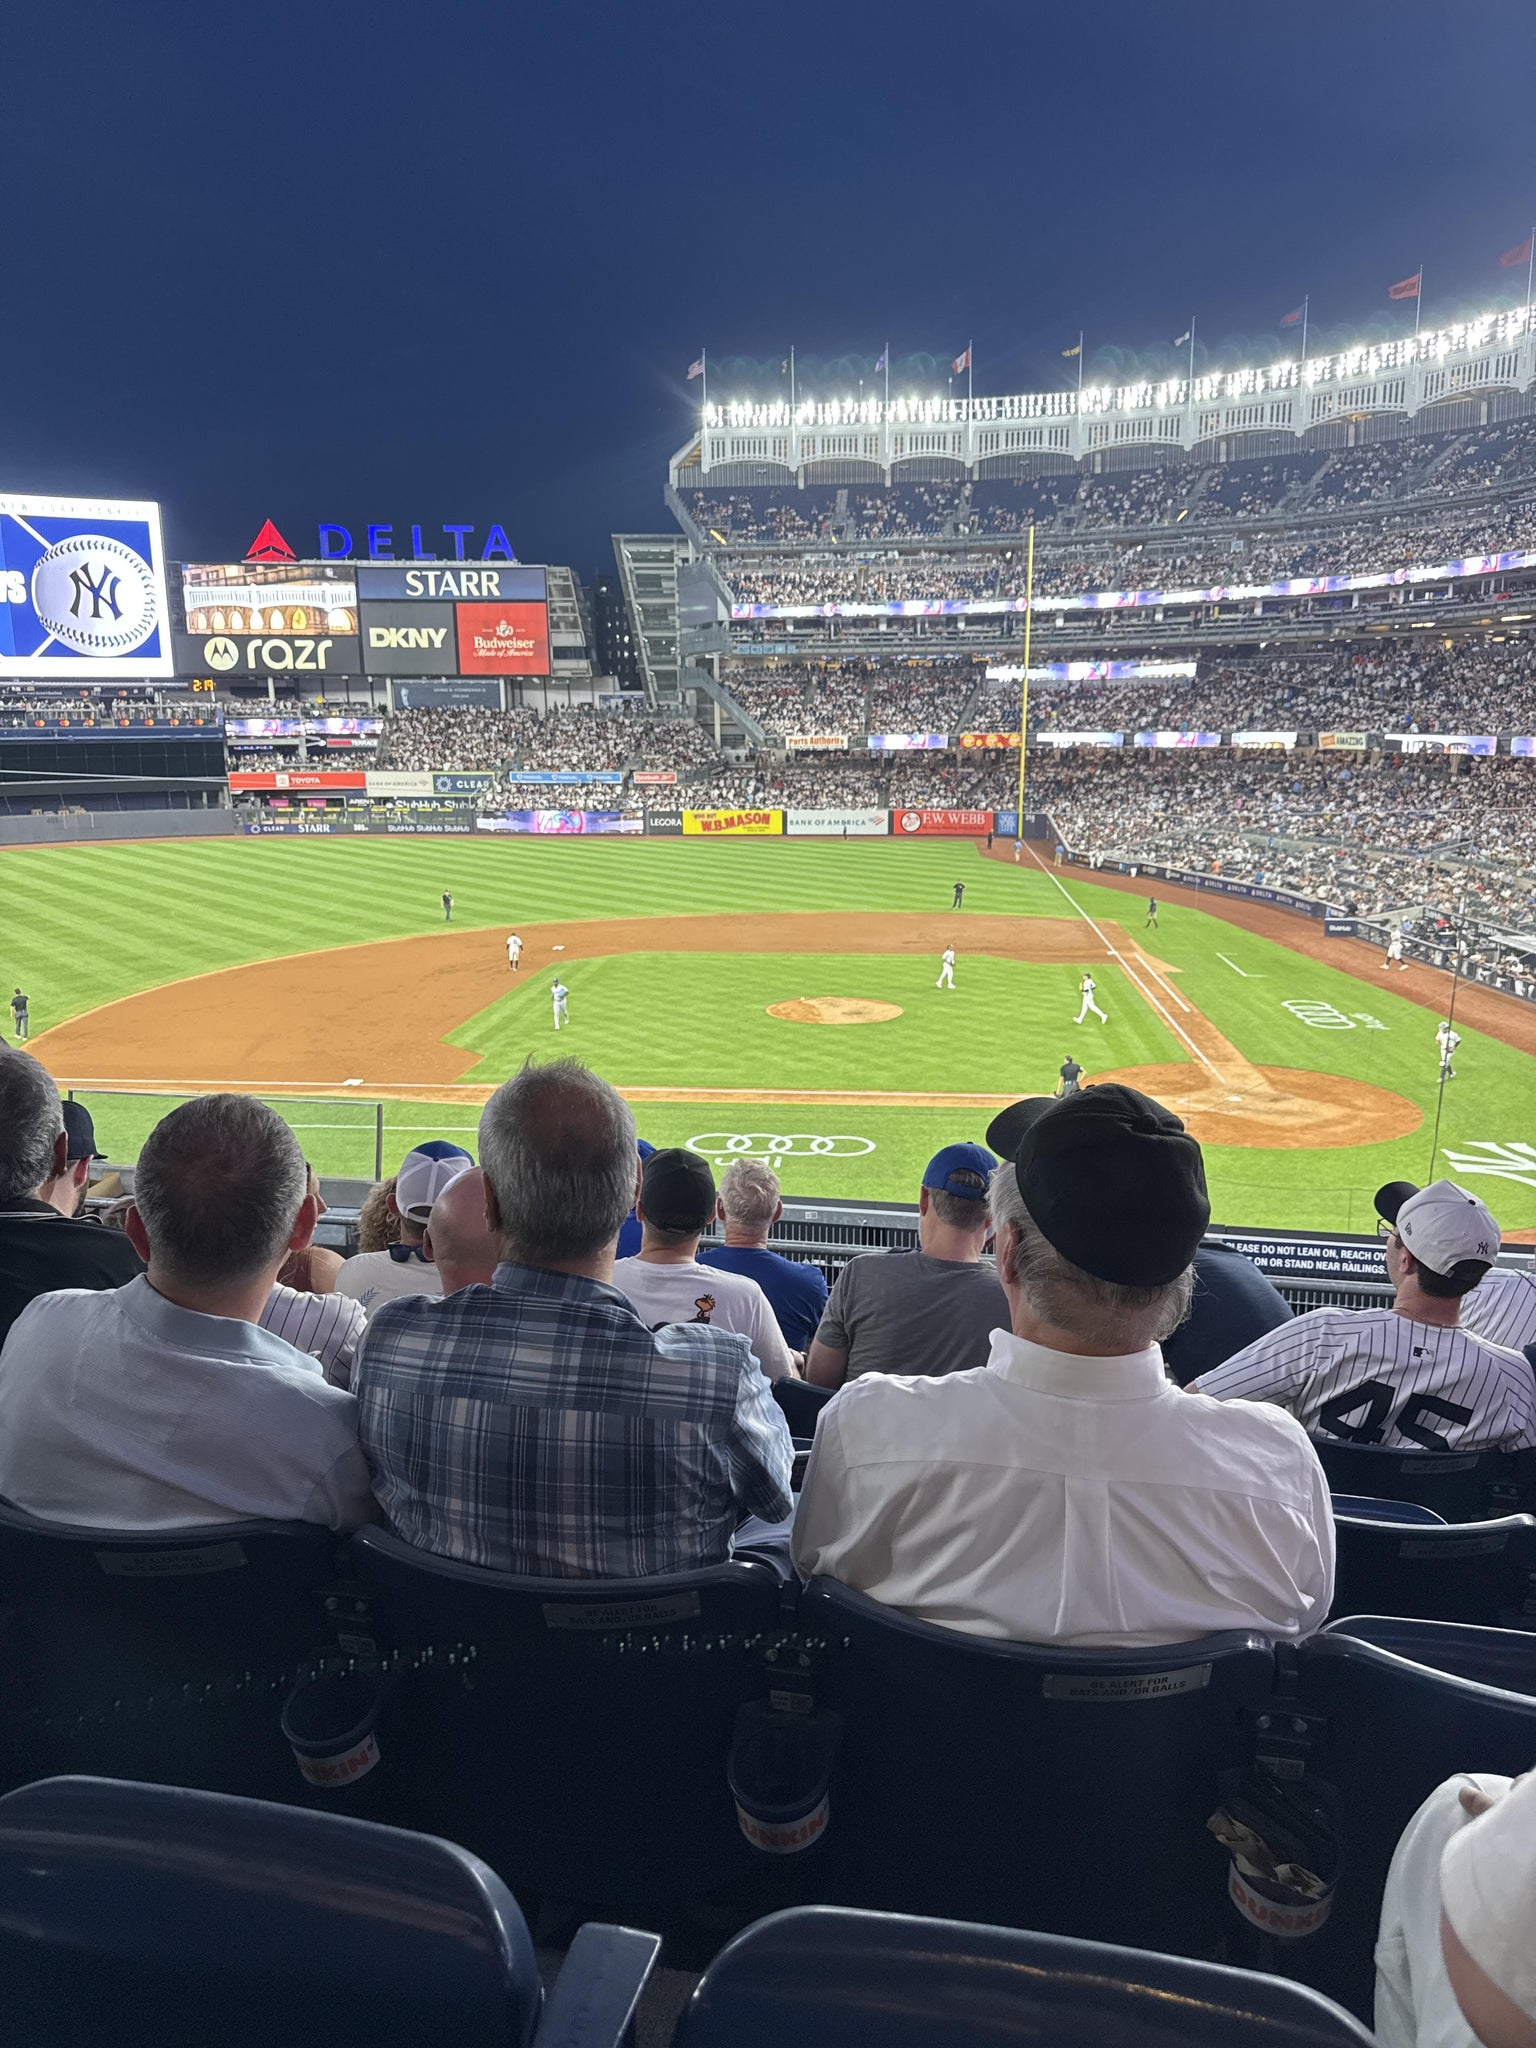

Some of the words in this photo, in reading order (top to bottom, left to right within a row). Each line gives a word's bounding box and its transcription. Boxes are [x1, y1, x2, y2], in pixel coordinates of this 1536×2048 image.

[319, 523, 516, 561] DELTA
[405, 570, 501, 597] STARR
[369, 627, 448, 648] DKNY
[474, 636, 535, 649] Budweiser
[246, 638, 333, 670] razr
[788, 737, 808, 746] Parts
[810, 737, 844, 746] Authority
[456, 780, 490, 789] CLEAR
[650, 818, 682, 827] LEGORA
[922, 813, 945, 825] F.W.
[948, 813, 986, 825] WEBB
[298, 824, 330, 833] STARR
[1226, 1242, 1259, 1254] PLEASE
[1261, 1244, 1274, 1254] DO
[1276, 1246, 1295, 1256] NOT
[1297, 1247, 1320, 1257] LEAN
[1322, 1248, 1338, 1260] ON,
[1341, 1249, 1371, 1261] REACH
[1373, 1251, 1388, 1262] OV
[1254, 1256, 1268, 1267] ON
[1269, 1257, 1283, 1267] OR
[1284, 1258, 1314, 1269] STAND
[1315, 1260, 1340, 1272] NEAR
[1342, 1261, 1387, 1275] RAILINGS.
[1070, 1687, 1099, 1696] BATS
[1152, 1680, 1187, 1693] BALLS
[1090, 1680, 1105, 1690] BE
[1108, 1679, 1143, 1689] ALERT
[1147, 1676, 1169, 1686] FOR
